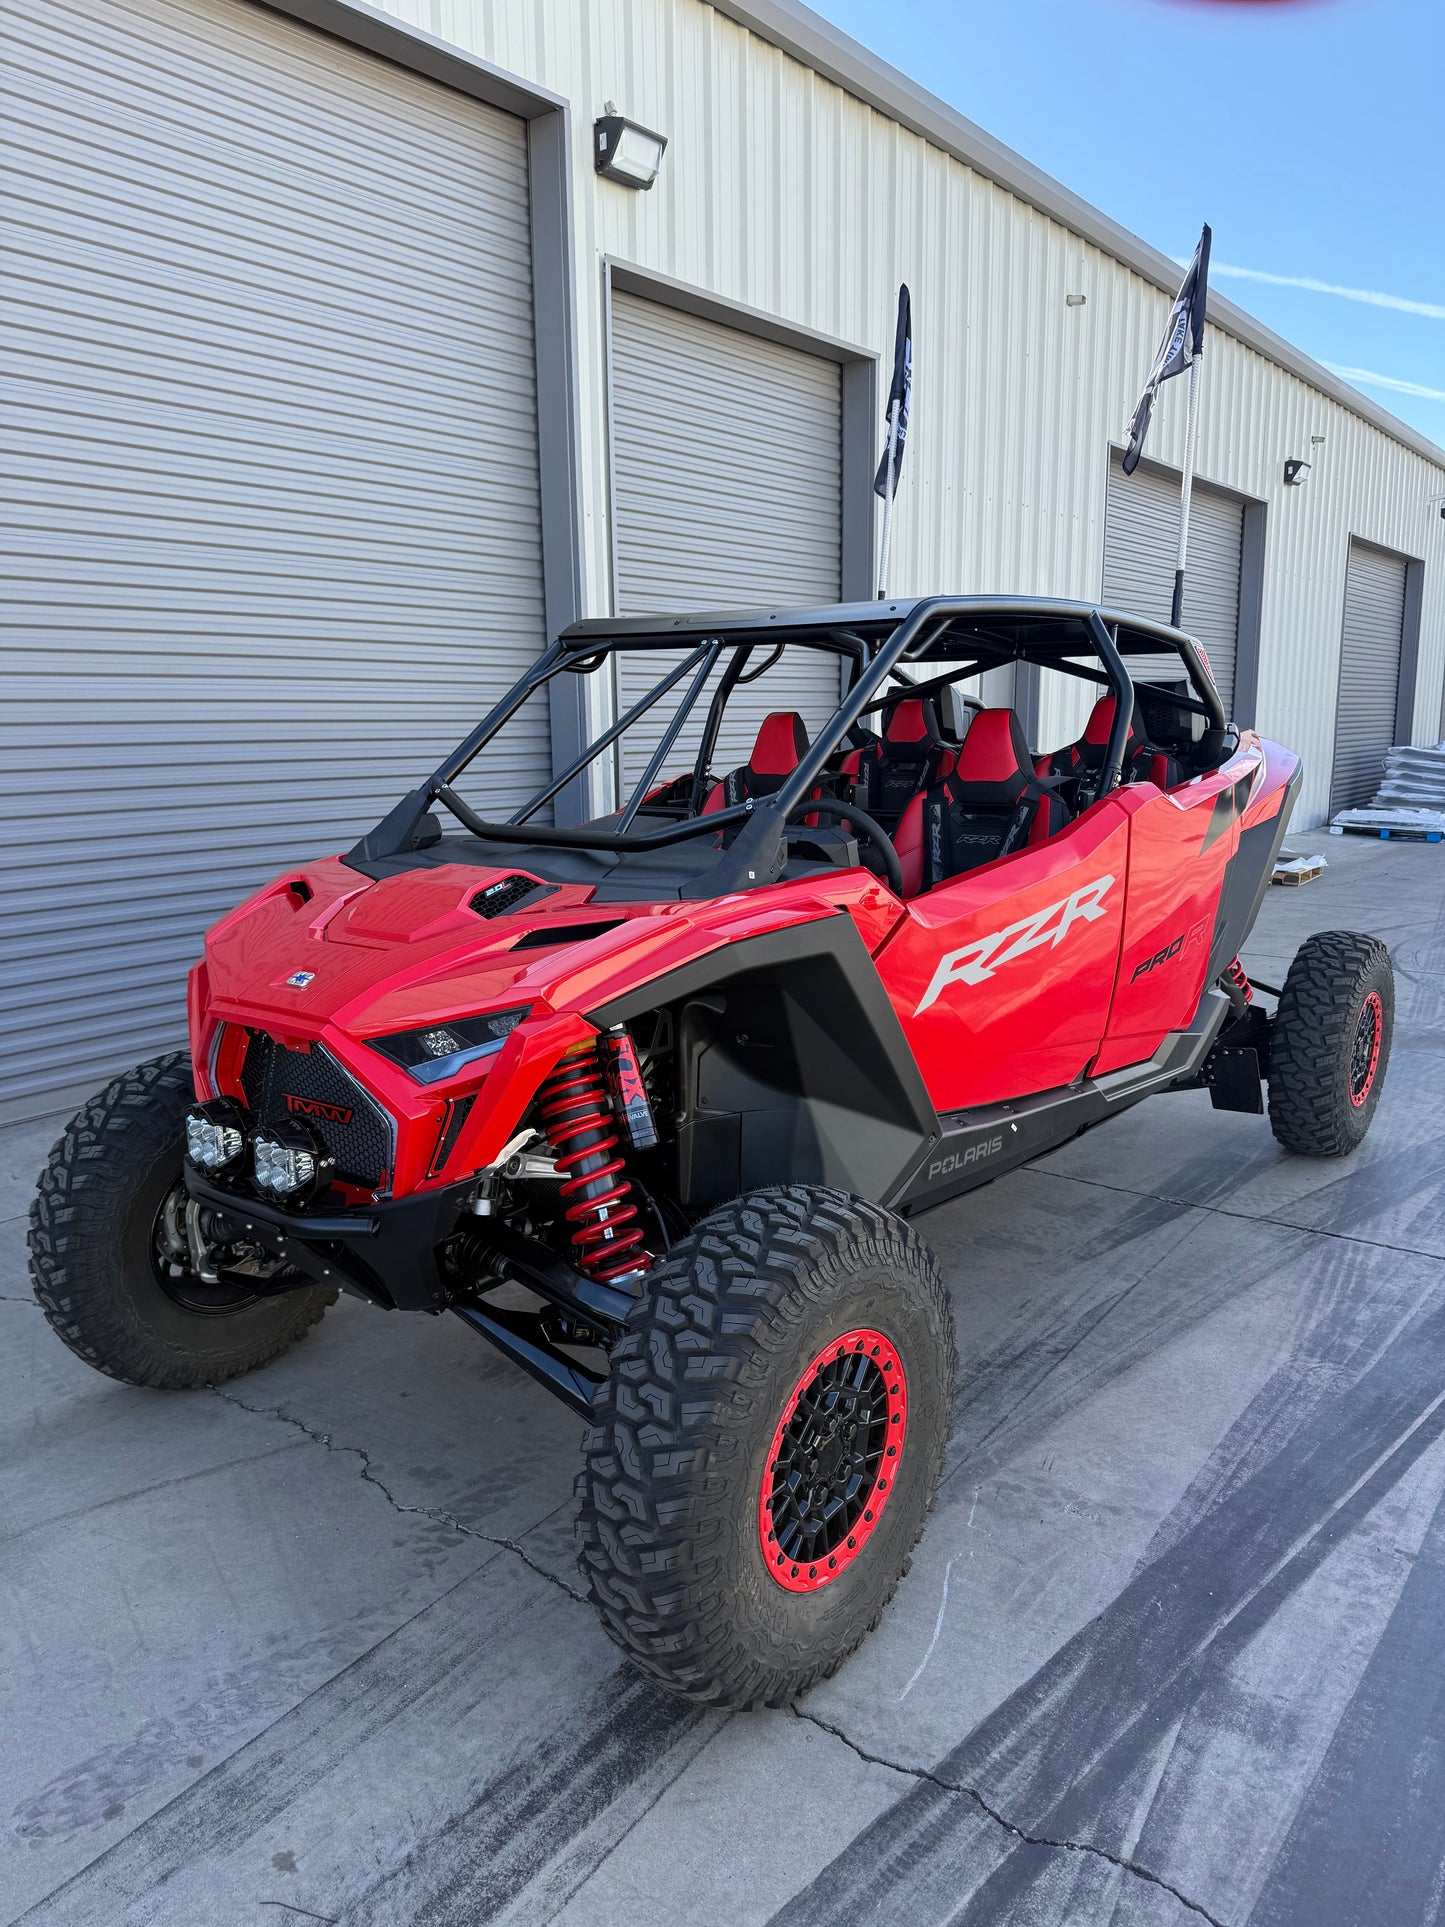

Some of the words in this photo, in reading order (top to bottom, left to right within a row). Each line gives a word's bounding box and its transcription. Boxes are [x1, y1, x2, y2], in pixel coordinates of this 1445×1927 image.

[955, 833, 1002, 846] RZR
[912, 874, 1116, 1018] RZR
[1129, 934, 1185, 985] PRO
[607, 1034, 648, 1106] FOX
[928, 1135, 1003, 1180] POLARIS
